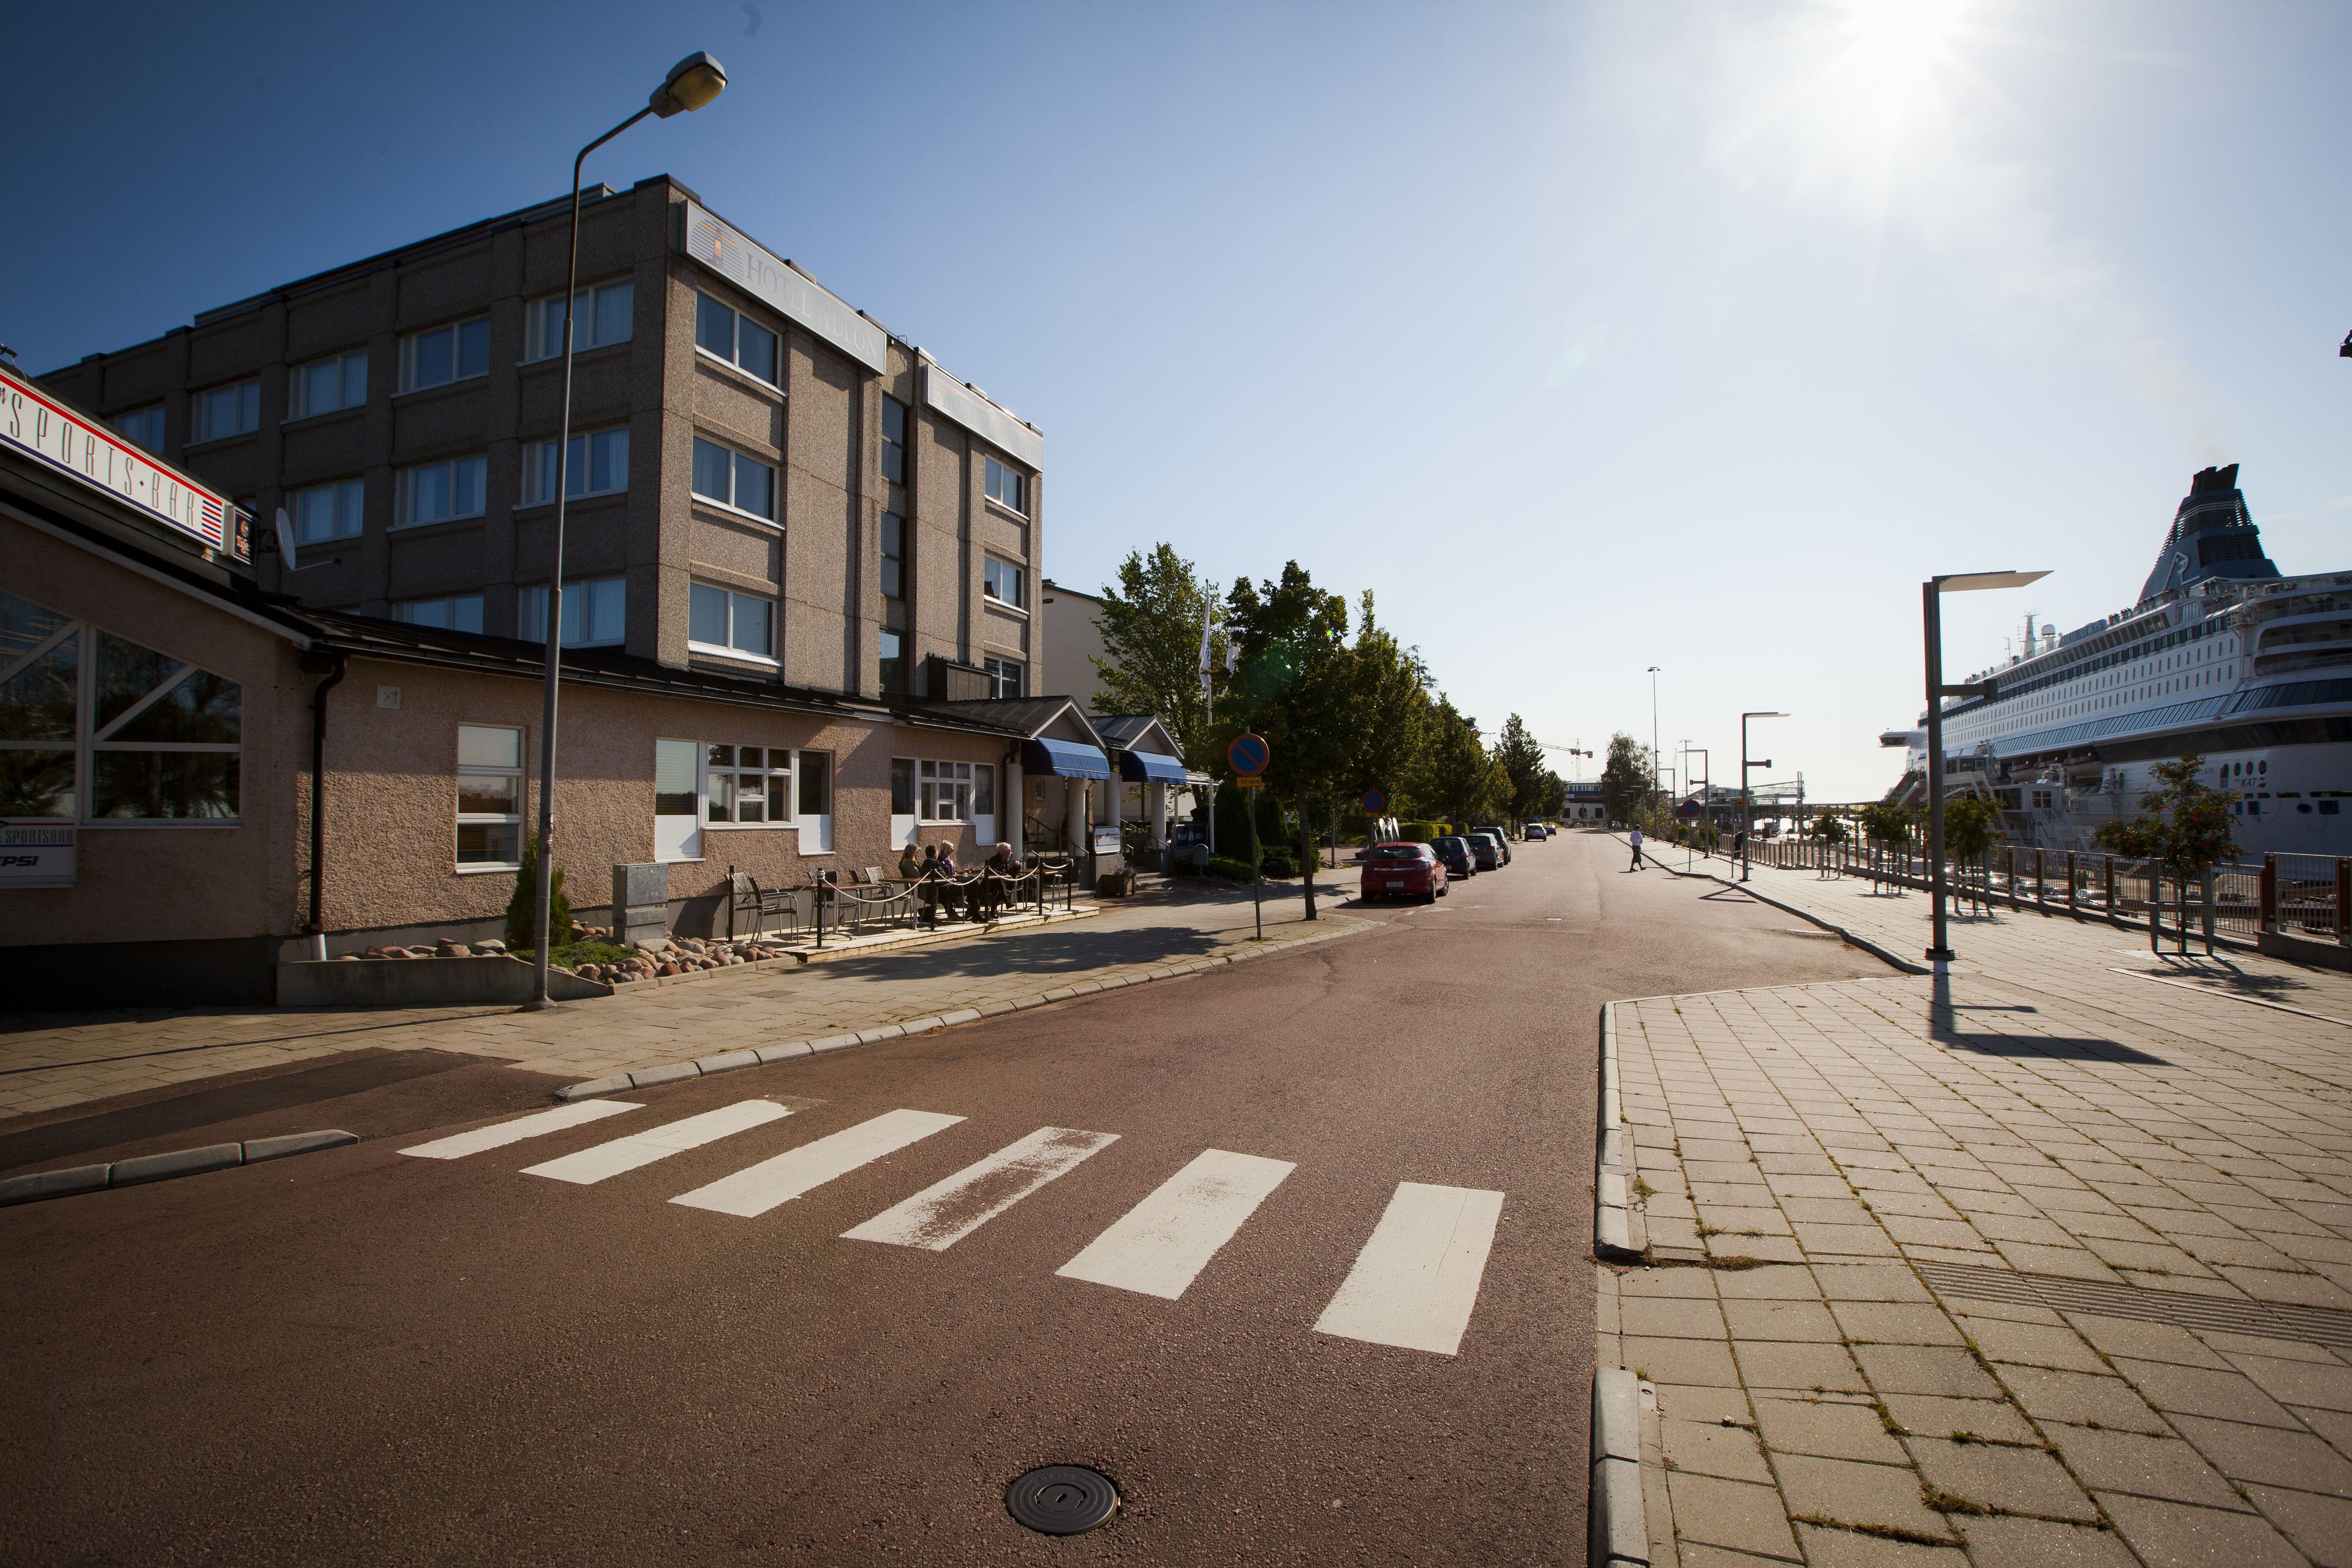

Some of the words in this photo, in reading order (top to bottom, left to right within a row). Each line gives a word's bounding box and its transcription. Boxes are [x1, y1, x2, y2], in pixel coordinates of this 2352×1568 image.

[746, 252, 812, 318] HOTEL
[818, 304, 878, 360] ADLON
[10, 393, 134, 496] SPORTS
[153, 472, 195, 527] BAR
[0, 856, 39, 866] PSI
[5, 829, 74, 843] SPORTSBAR
